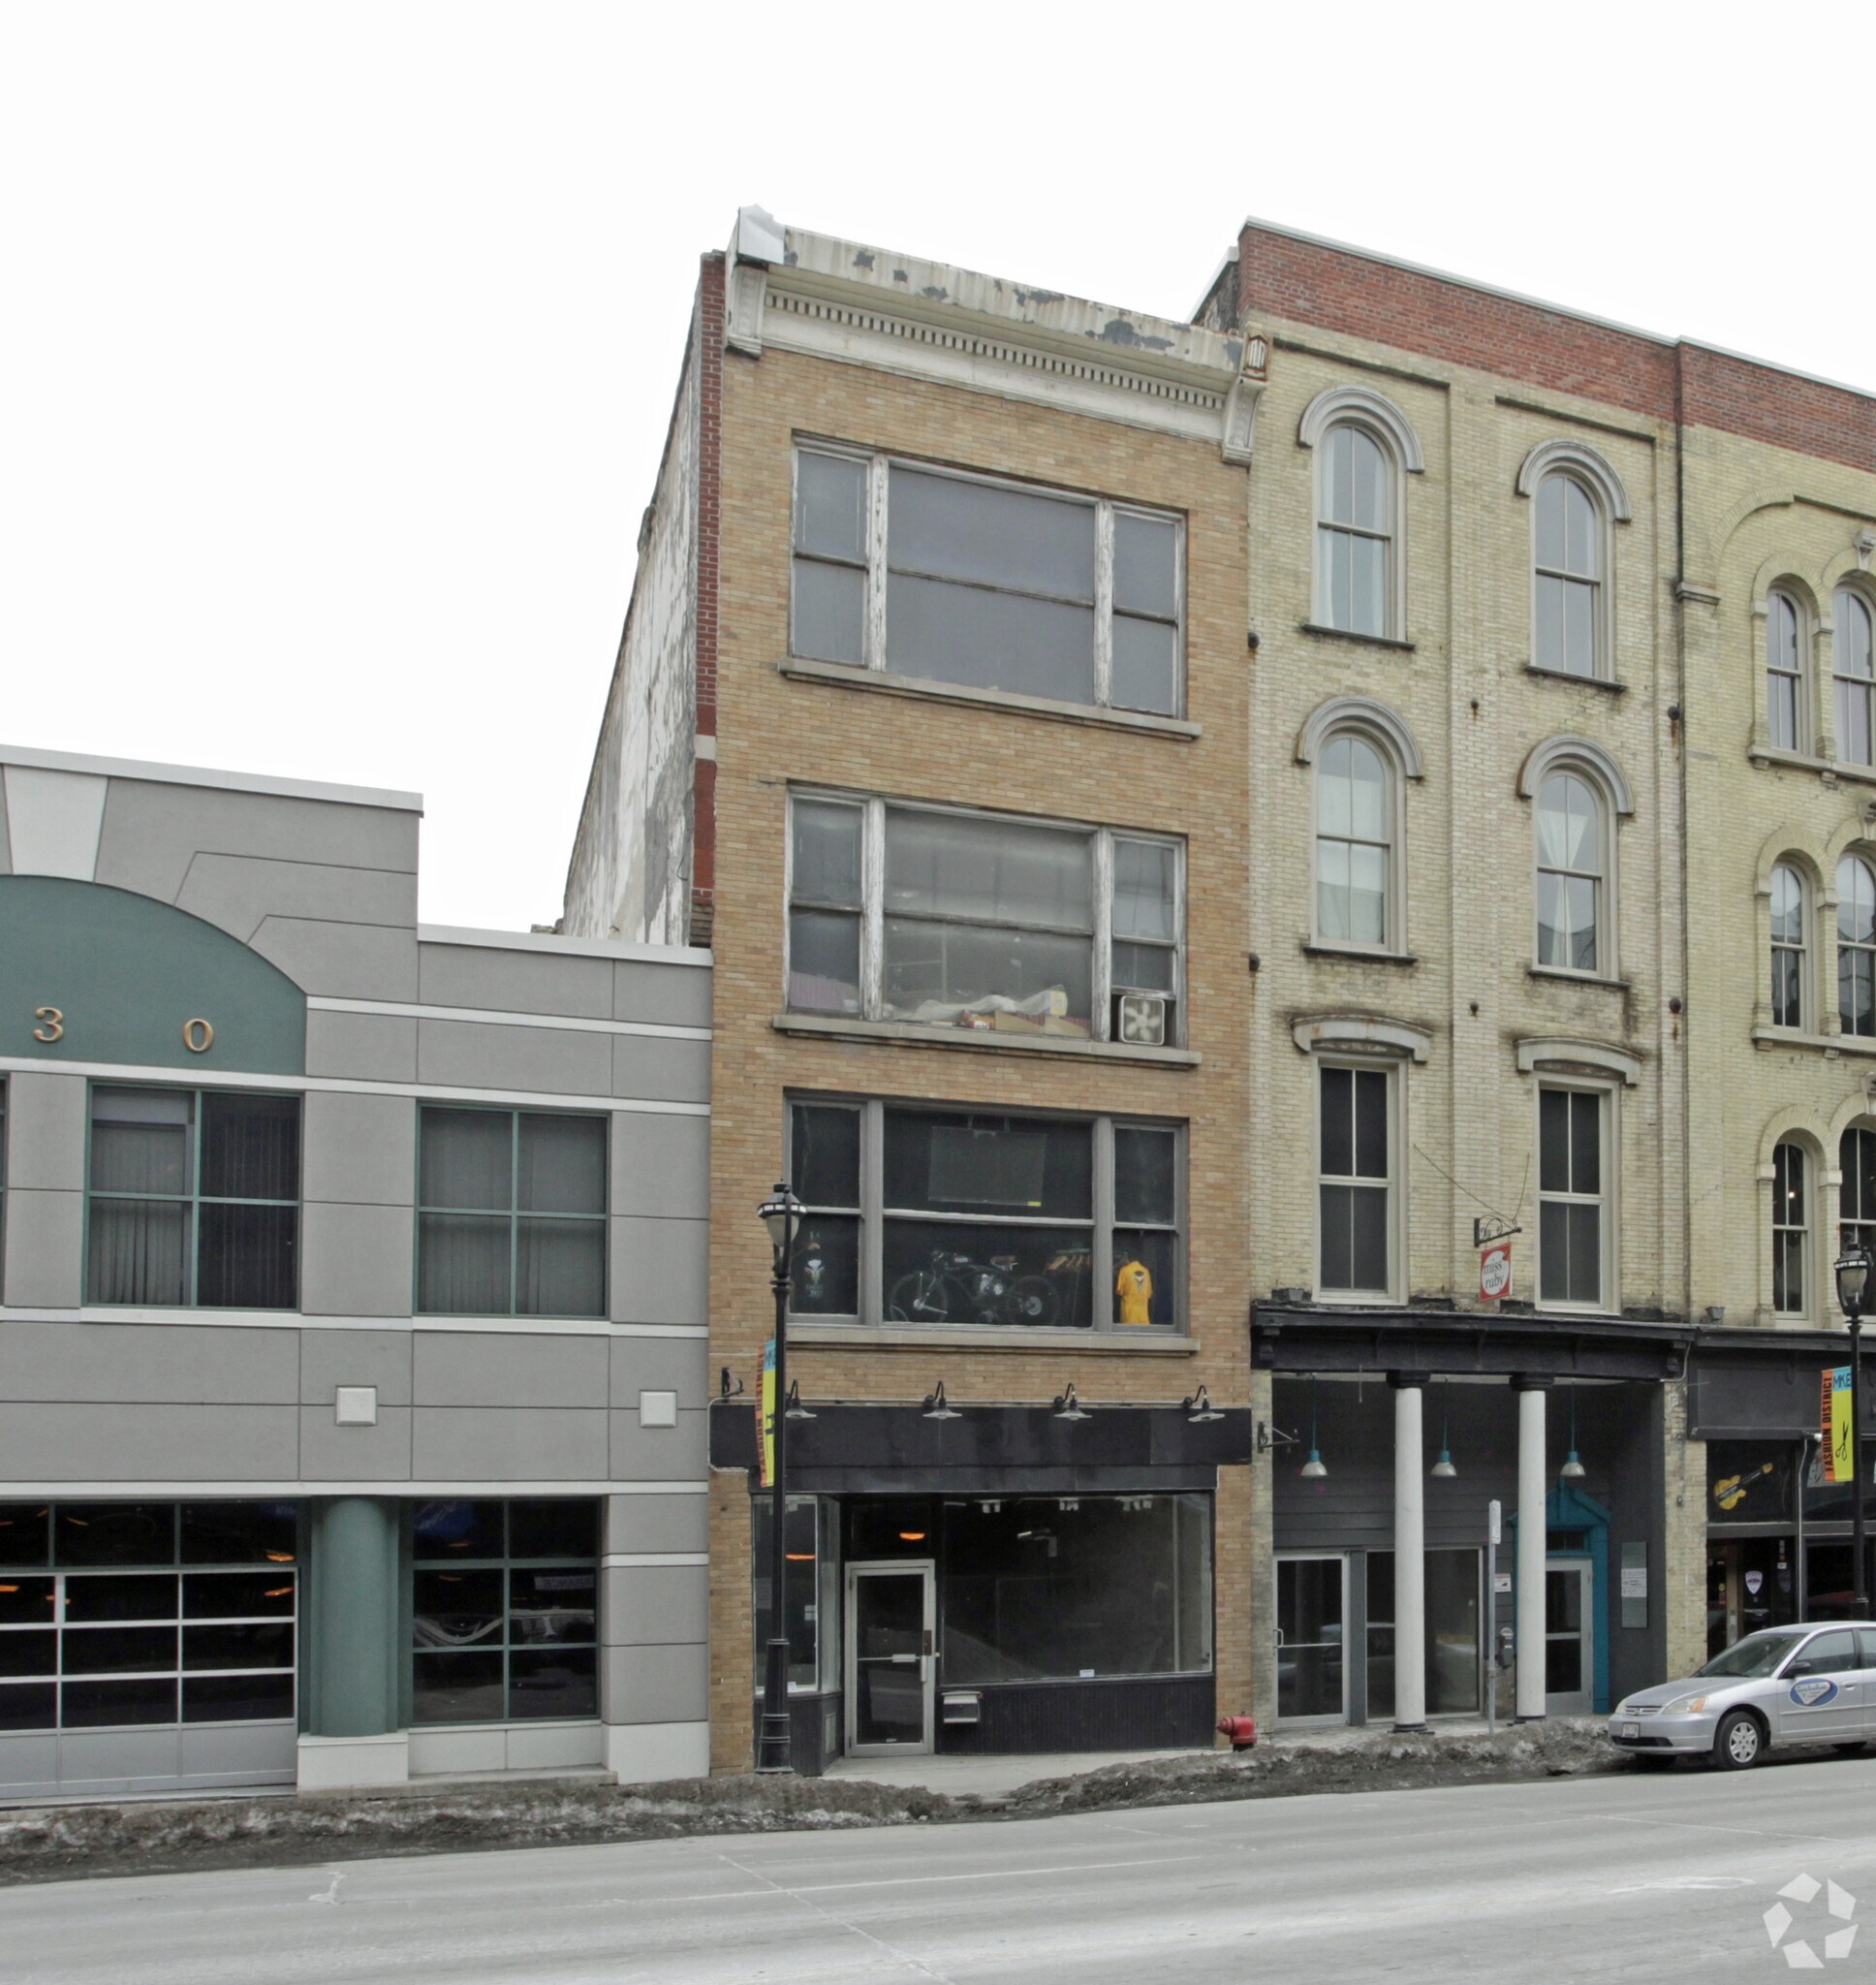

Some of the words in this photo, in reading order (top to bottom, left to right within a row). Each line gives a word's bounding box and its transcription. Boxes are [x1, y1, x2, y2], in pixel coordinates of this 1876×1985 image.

[34, 1007, 64, 1043] 3
[1484, 1258, 1502, 1274] miss
[1485, 1273, 1504, 1289] ruby
[1832, 1372, 1851, 1389] MKE
[1823, 1377, 1831, 1423] DISTRICT
[1823, 1428, 1833, 1471] FASHION
